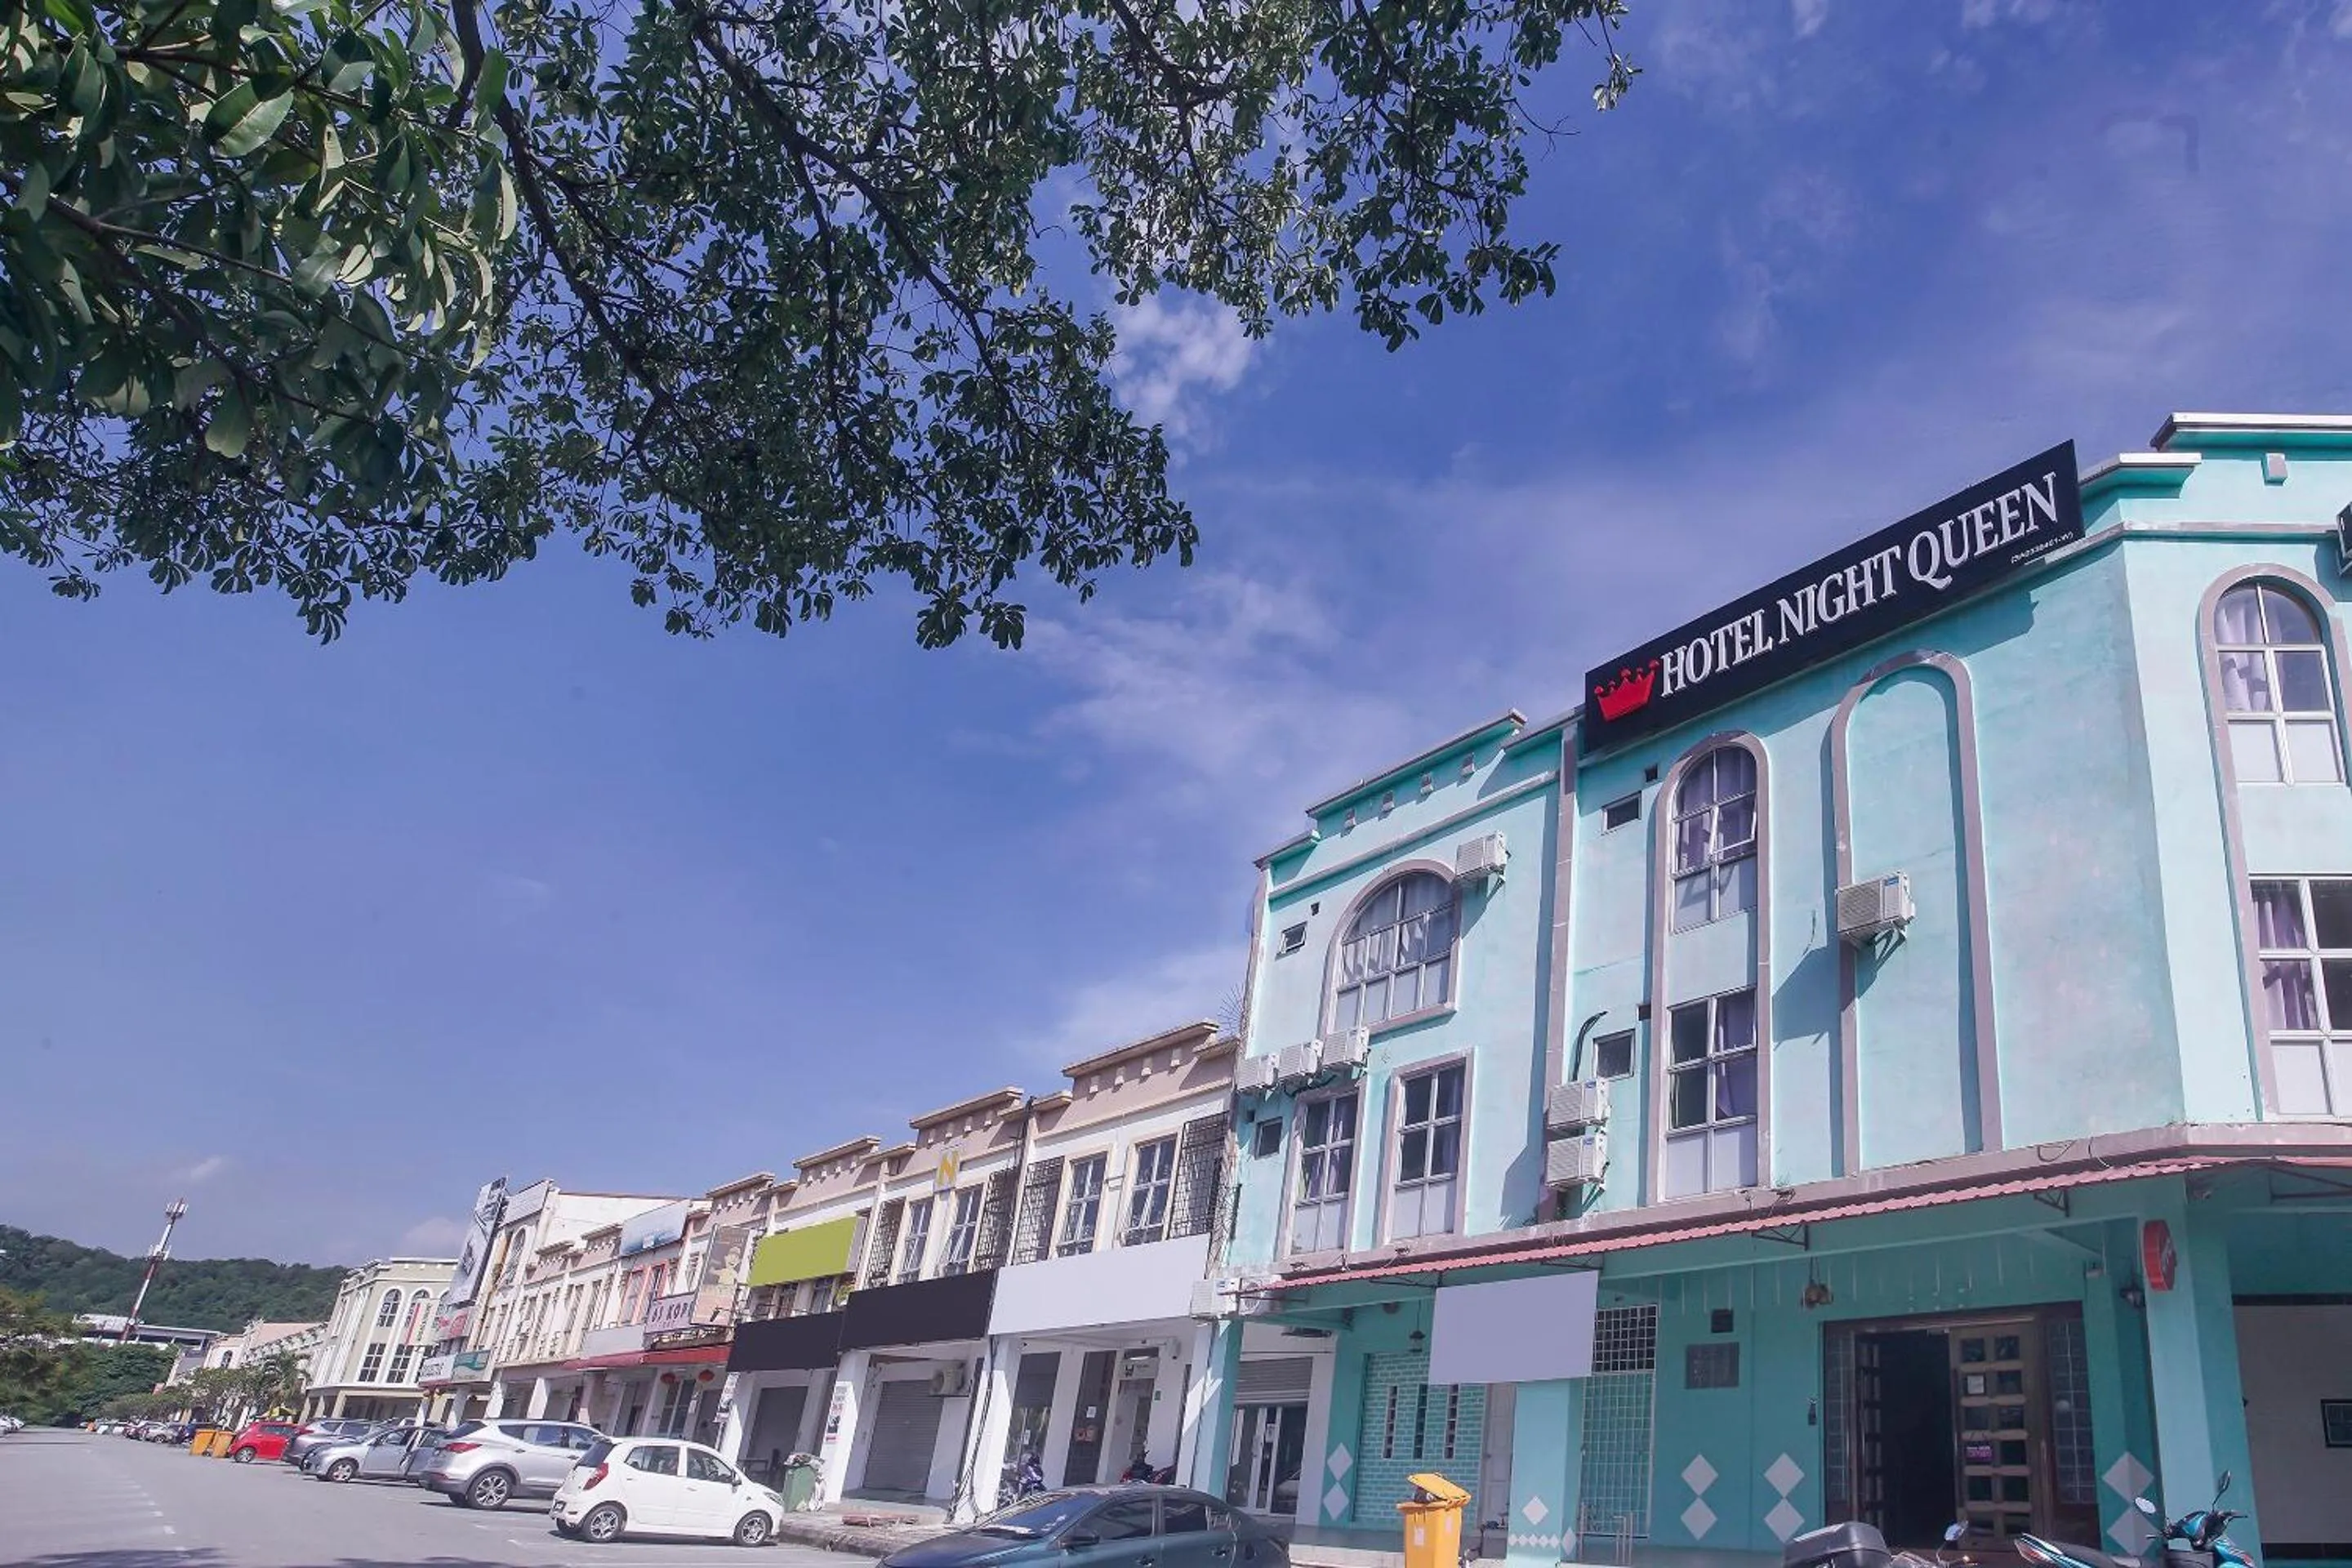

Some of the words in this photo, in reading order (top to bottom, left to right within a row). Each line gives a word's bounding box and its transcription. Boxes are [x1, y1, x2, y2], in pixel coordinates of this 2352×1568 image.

[1661, 608, 1773, 697] HOTEL
[1776, 546, 1901, 644] NIGHT
[1908, 471, 2057, 590] QUEEN
